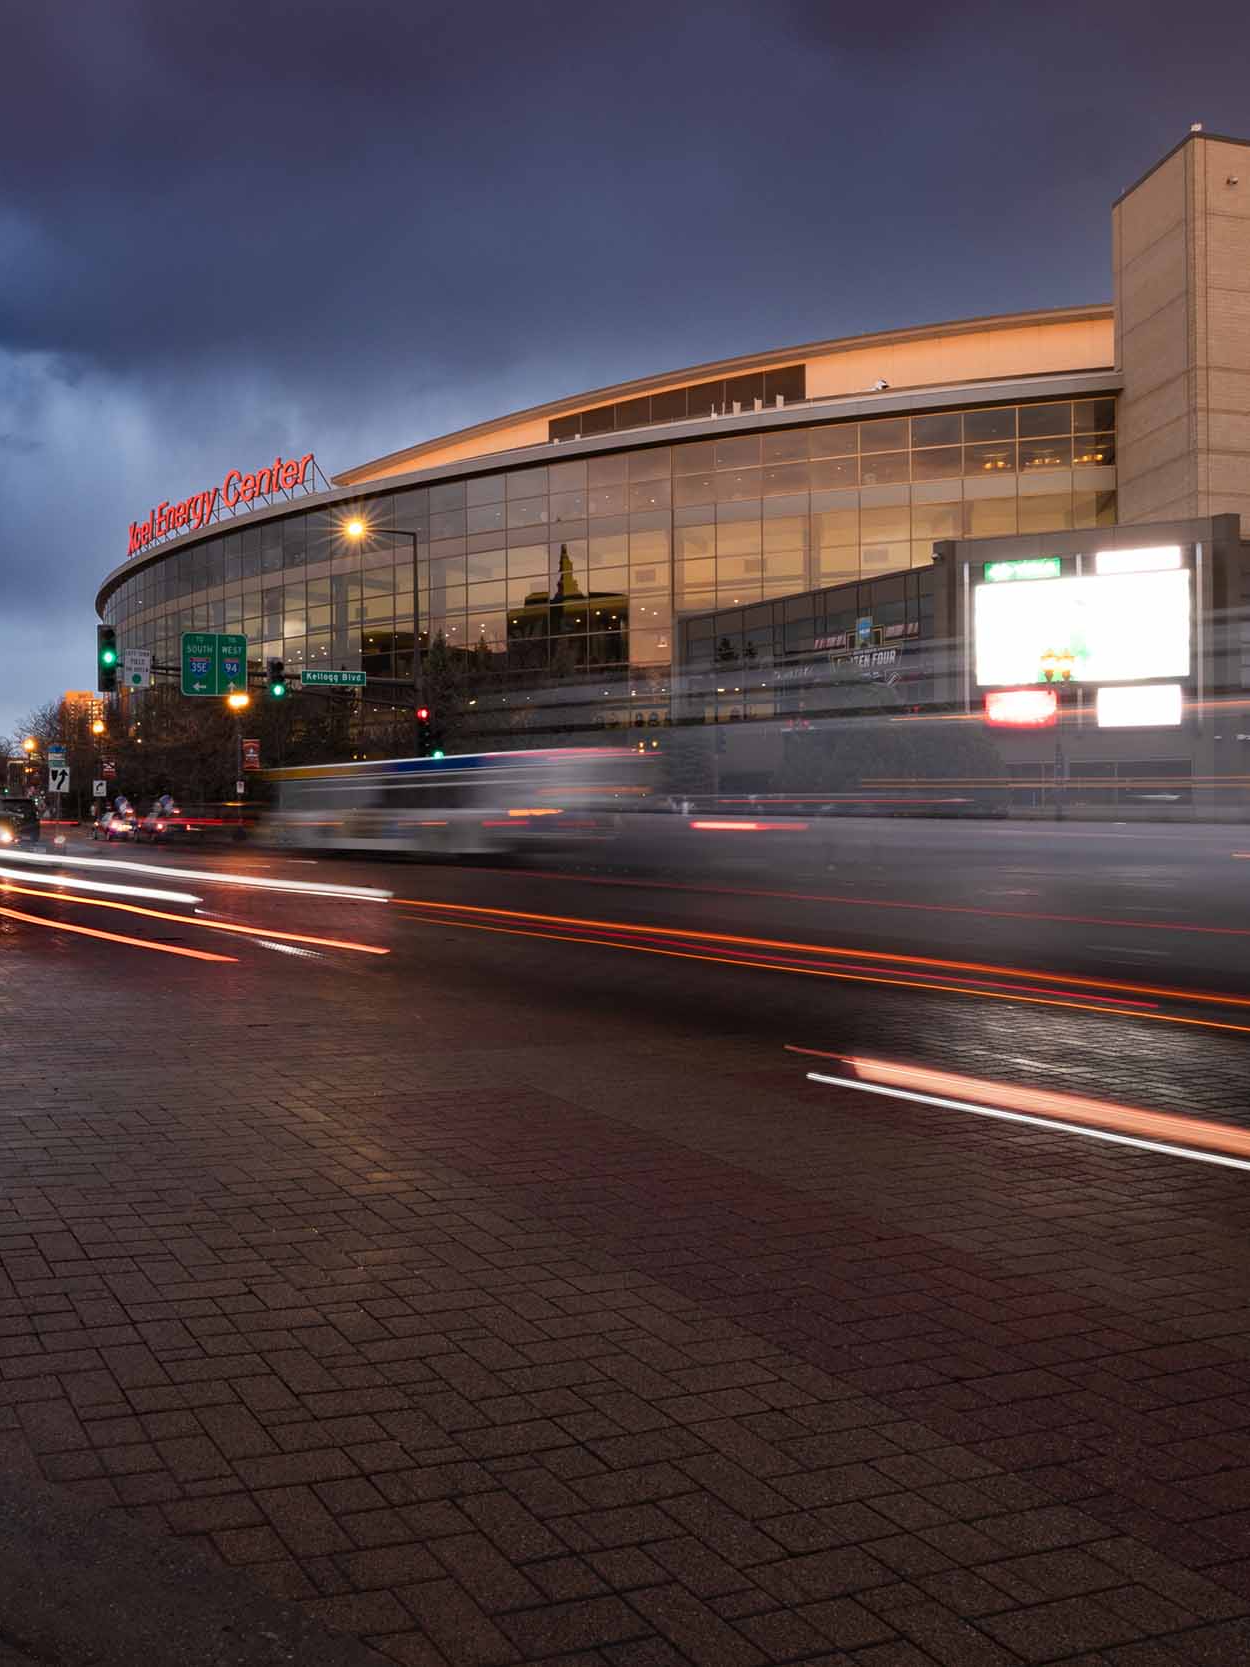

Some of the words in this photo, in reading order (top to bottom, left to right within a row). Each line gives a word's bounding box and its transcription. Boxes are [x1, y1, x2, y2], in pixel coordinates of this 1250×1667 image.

[127, 509, 154, 556] Xcel
[155, 487, 218, 538] Energy
[222, 452, 314, 508] Center
[186, 645, 213, 654] SOUTH
[221, 645, 242, 654] WEST
[871, 649, 897, 667] FOUR
[191, 662, 207, 673] 35E
[225, 663, 237, 673] 94
[306, 672, 339, 683] Kellogg
[342, 673, 362, 681] Blvd
